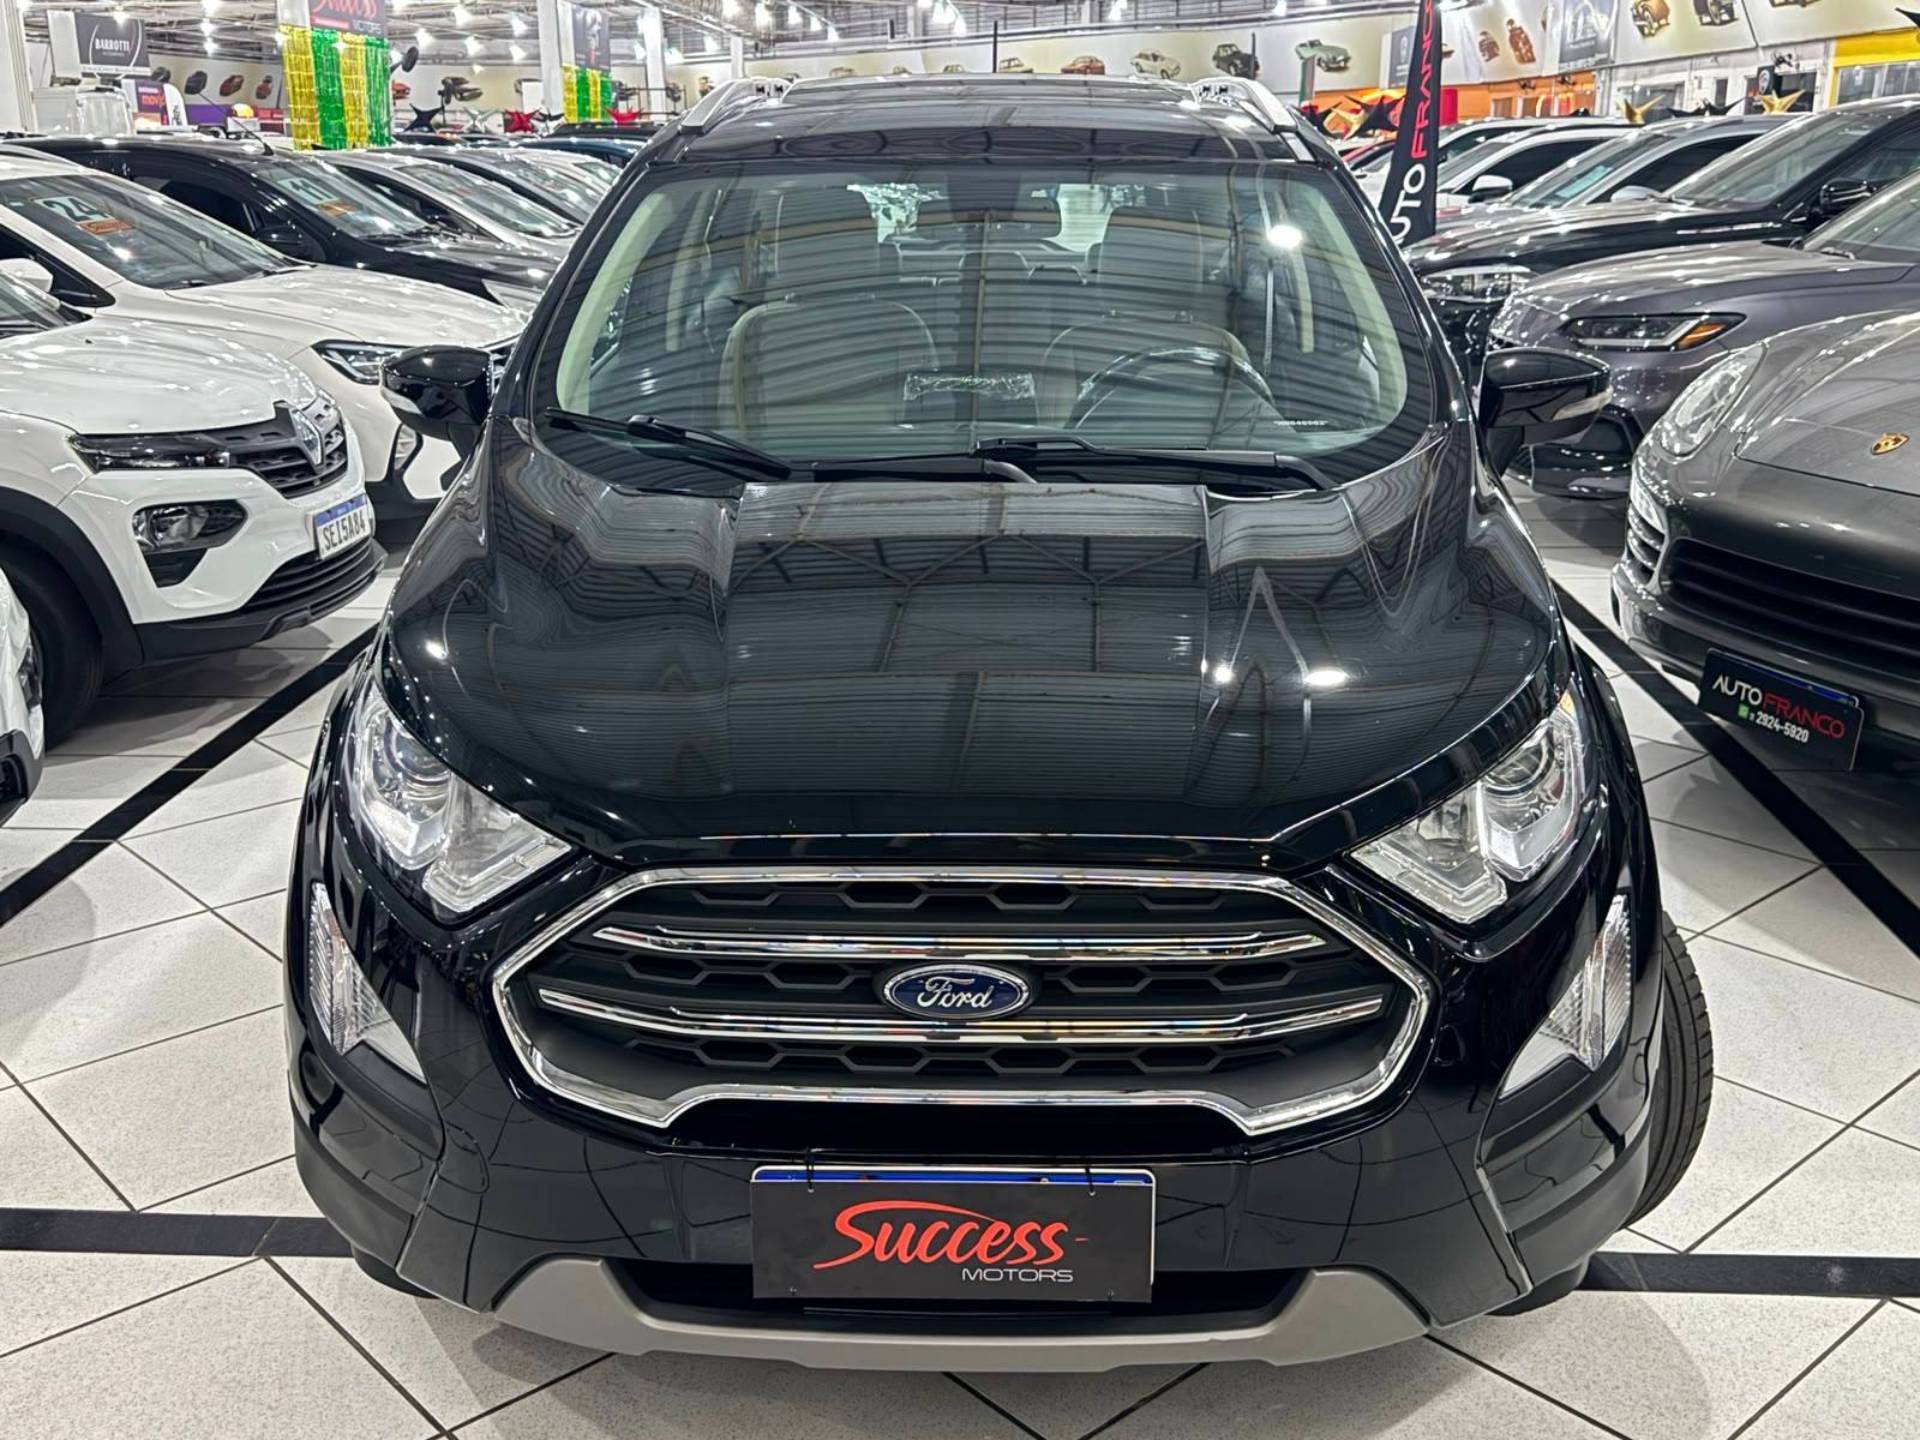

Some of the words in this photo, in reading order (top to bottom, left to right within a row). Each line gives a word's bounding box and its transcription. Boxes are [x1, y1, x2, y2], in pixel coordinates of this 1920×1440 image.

[95, 38, 130, 52] BARROTTI
[42, 198, 109, 222] 24
[1756, 711, 1809, 743] 2924-5920
[917, 976, 995, 1008] Ford
[813, 1200, 1069, 1269] Success
[961, 1267, 1074, 1283] MOTORS
